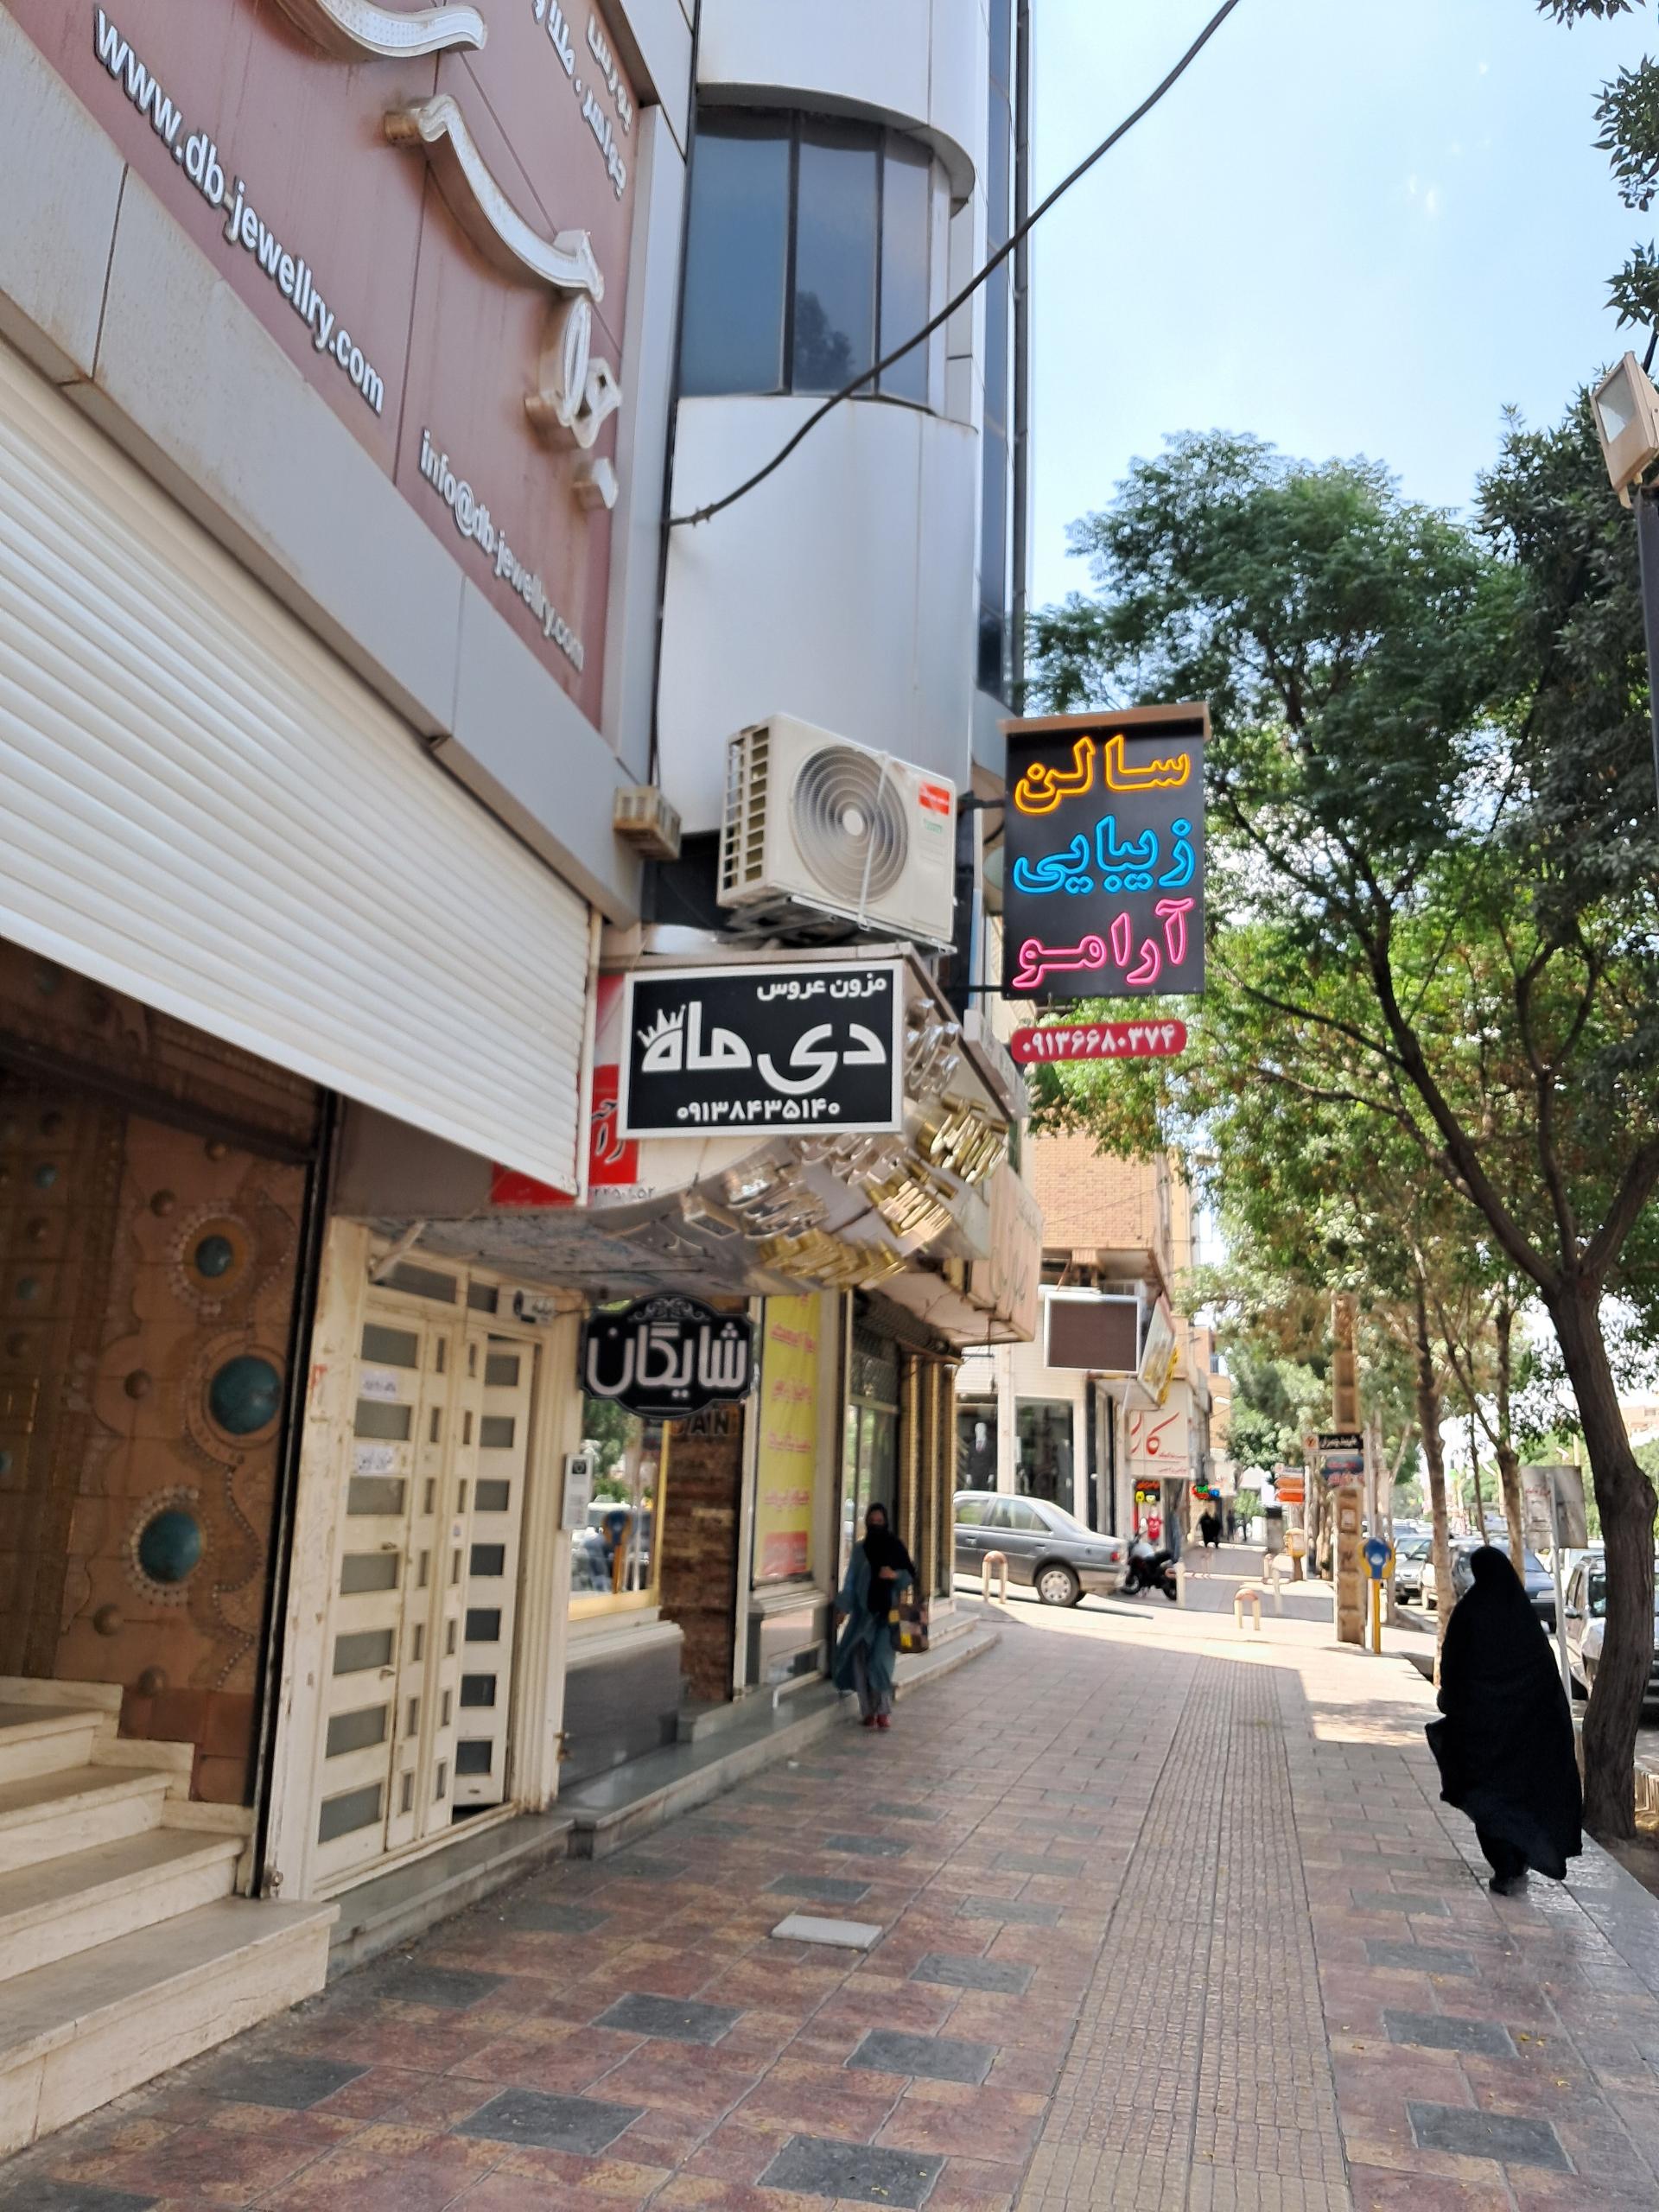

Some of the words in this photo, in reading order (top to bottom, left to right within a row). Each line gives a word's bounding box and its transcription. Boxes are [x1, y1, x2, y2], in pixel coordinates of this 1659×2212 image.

[582, 87, 626, 199] جواهر
[95, 7, 385, 418] www.db-jewellry.com
[1014, 734, 1191, 814] سالن
[1013, 814, 1196, 893] زیبایی
[757, 980, 826, 1001] عروس
[830, 973, 887, 998] مزون
[640, 1001, 753, 1072] ماه
[757, 1023, 887, 1095] دی
[1022, 1024, 1175, 1057] ۰۹۱۳۶۶۸۰۳۷۴
[677, 1098, 840, 1122] ۰۹۱۳۸۴۳۵۱۴۰
[587, 1322, 747, 1399] شایگان
